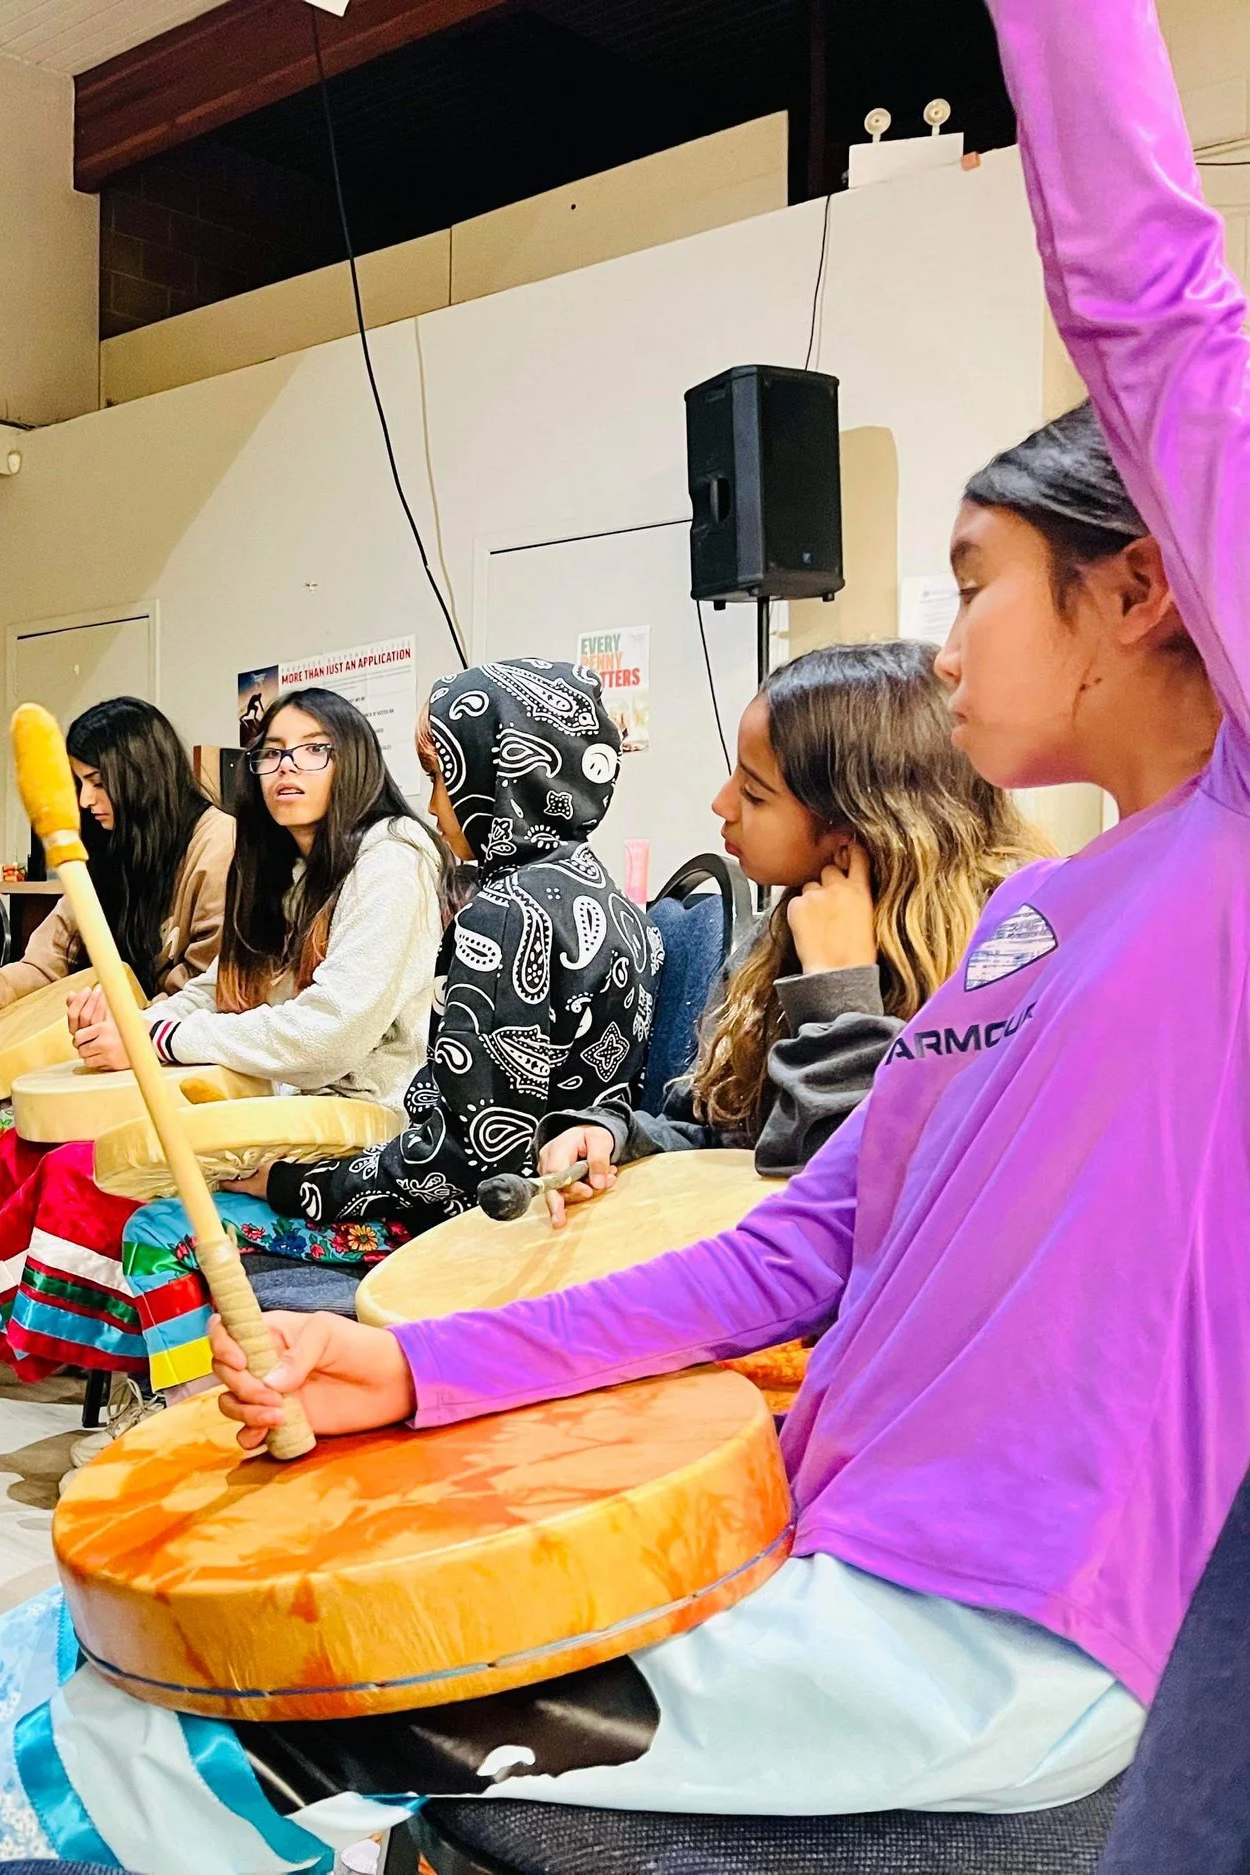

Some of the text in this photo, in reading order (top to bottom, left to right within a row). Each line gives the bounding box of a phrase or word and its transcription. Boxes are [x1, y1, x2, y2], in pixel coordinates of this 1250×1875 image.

[581, 633, 621, 655] EVERY
[281, 671, 302, 685] MORE
[304, 667, 325, 681] THAN
[326, 662, 343, 675] JUST
[345, 660, 356, 671] AN
[357, 648, 411, 668] APPLICATION
[599, 667, 641, 688] TTERS
